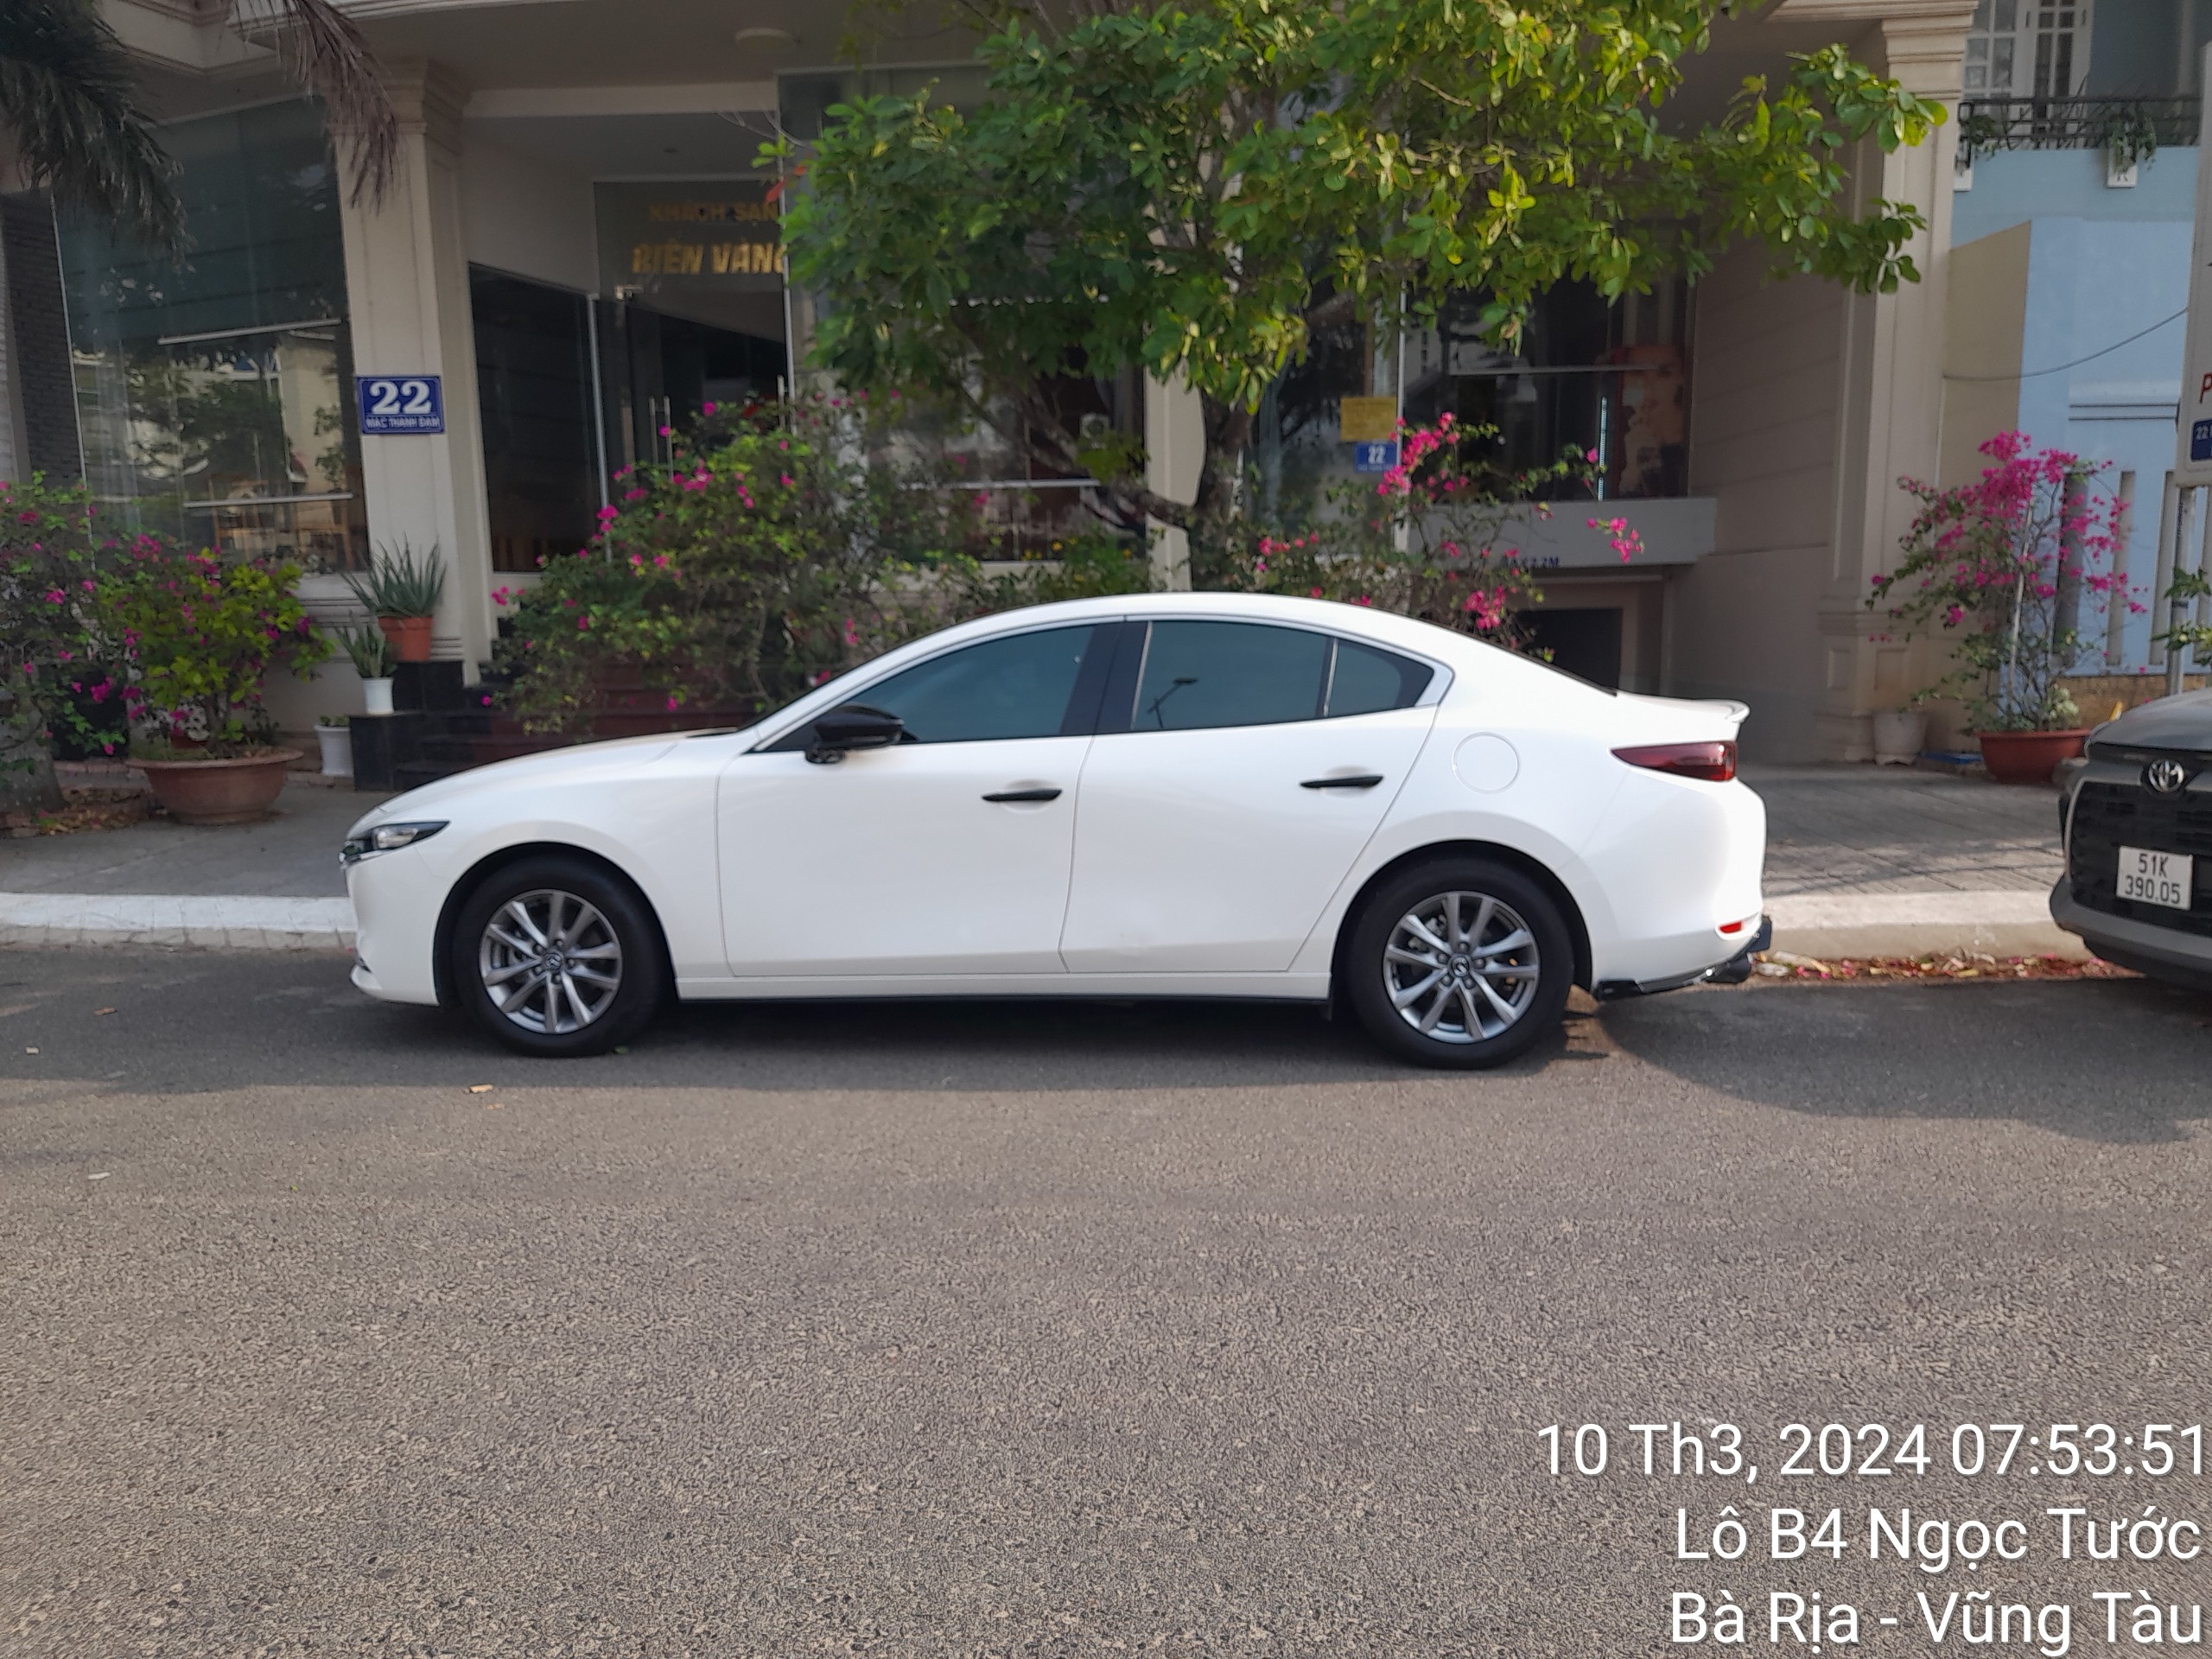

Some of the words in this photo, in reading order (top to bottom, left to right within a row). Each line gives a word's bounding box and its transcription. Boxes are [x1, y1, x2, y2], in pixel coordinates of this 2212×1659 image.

[369, 380, 432, 416] 22
[1368, 444, 1387, 465] 22
[2138, 853, 2169, 879] 51K
[2125, 874, 2181, 905] 390.05
